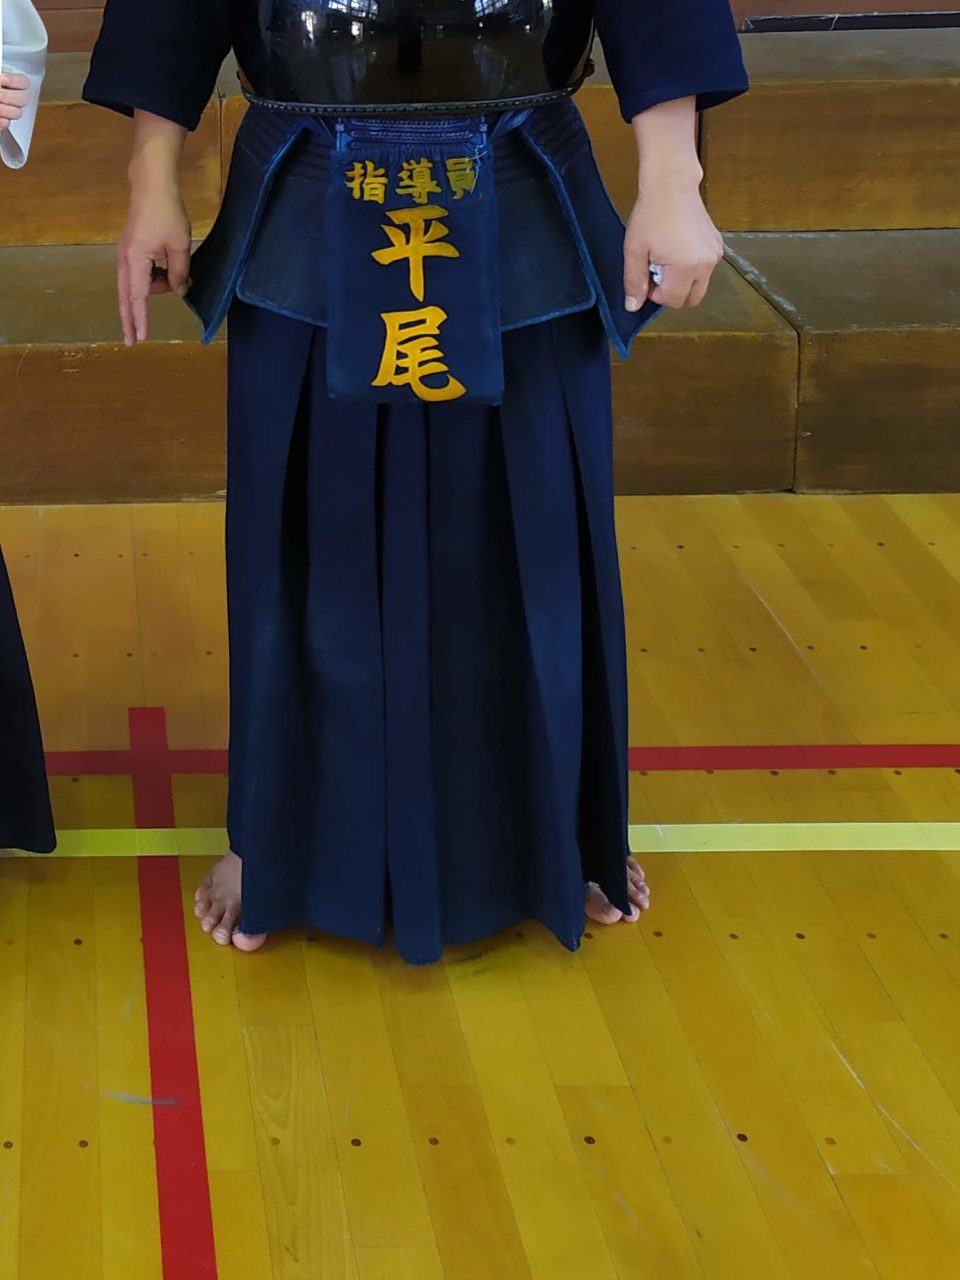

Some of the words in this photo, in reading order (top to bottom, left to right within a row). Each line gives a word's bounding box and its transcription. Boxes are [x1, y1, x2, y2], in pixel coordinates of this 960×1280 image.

[344, 156, 483, 205] 指導員
[370, 205, 468, 403] 平尾
